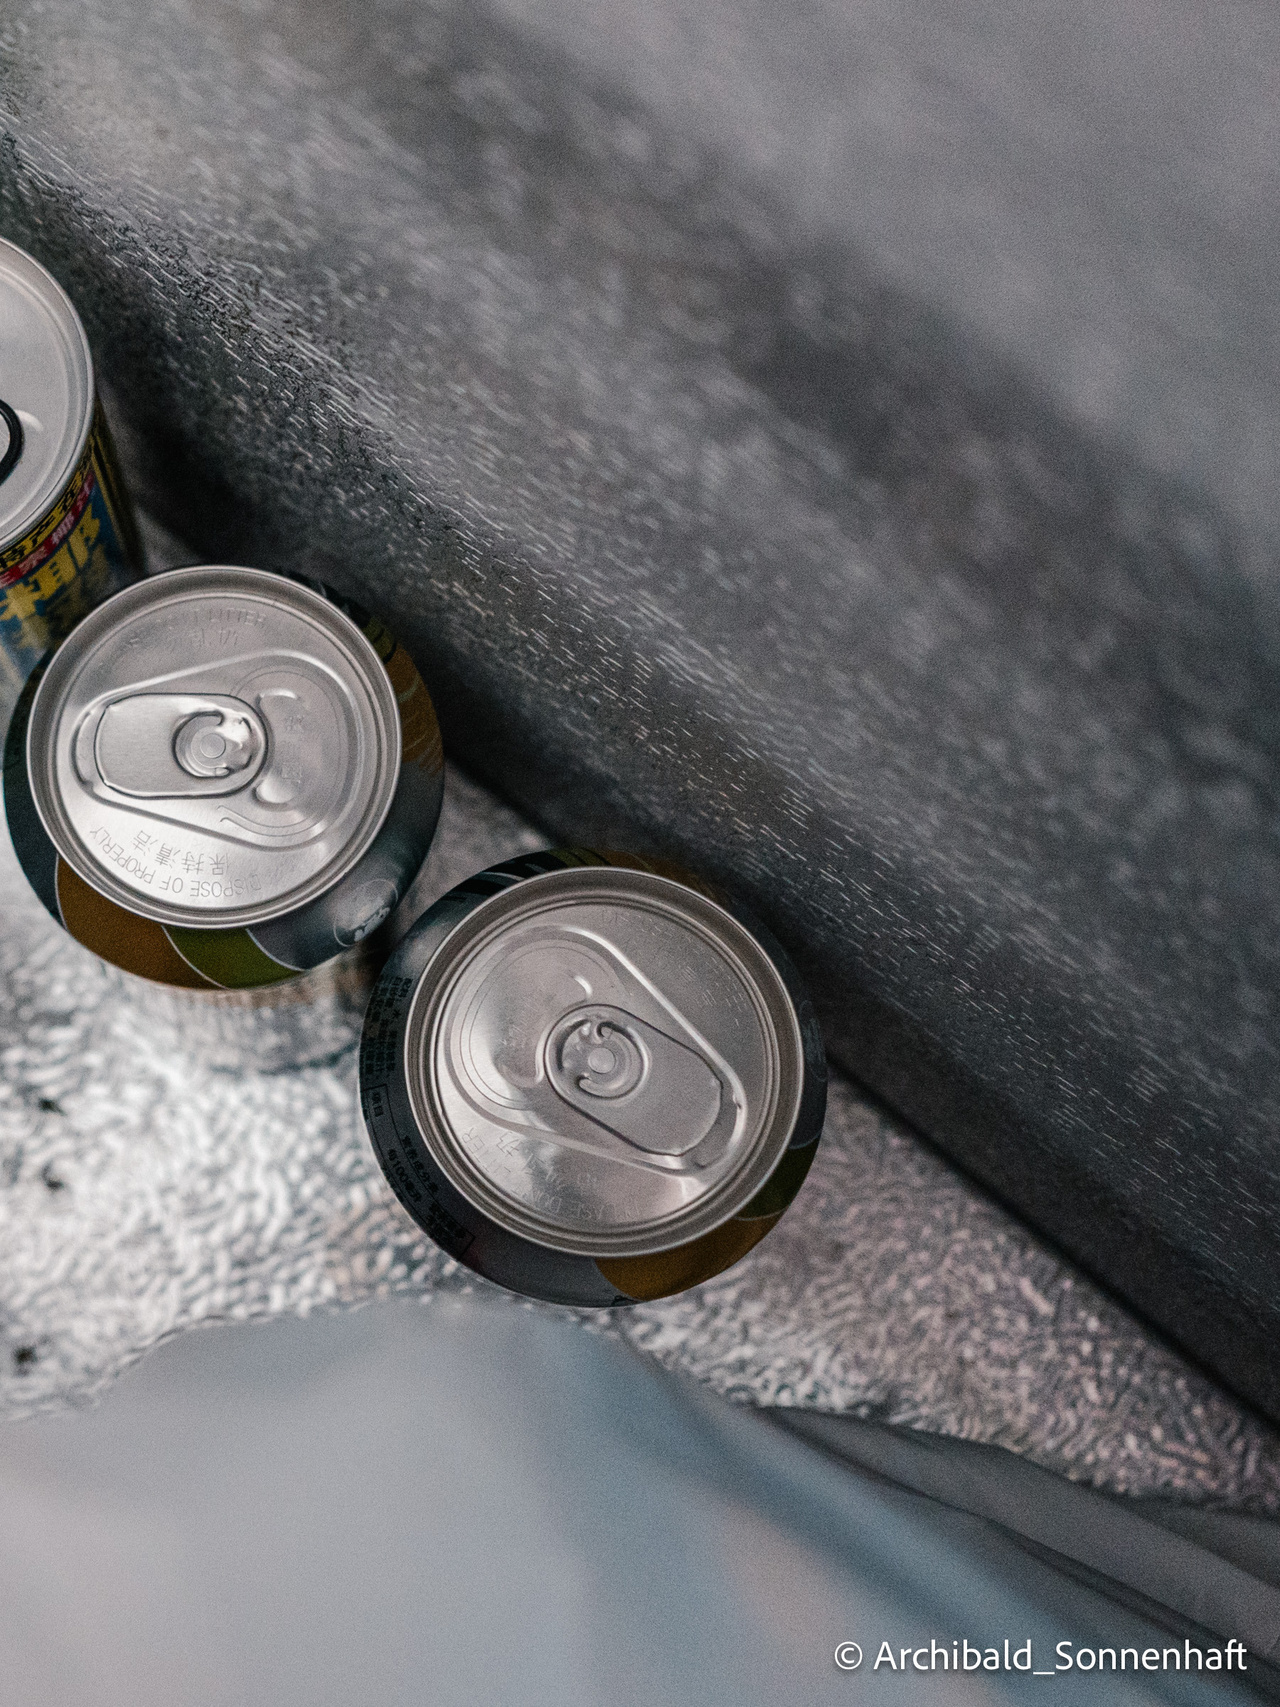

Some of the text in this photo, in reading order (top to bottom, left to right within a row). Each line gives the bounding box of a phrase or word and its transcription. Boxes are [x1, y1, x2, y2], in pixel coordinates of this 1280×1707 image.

[89, 826, 262, 897] DISPOSE OF PROPERLY
[130, 830, 228, 876] 保持清洁
[459, 1126, 512, 1185] LITTER
